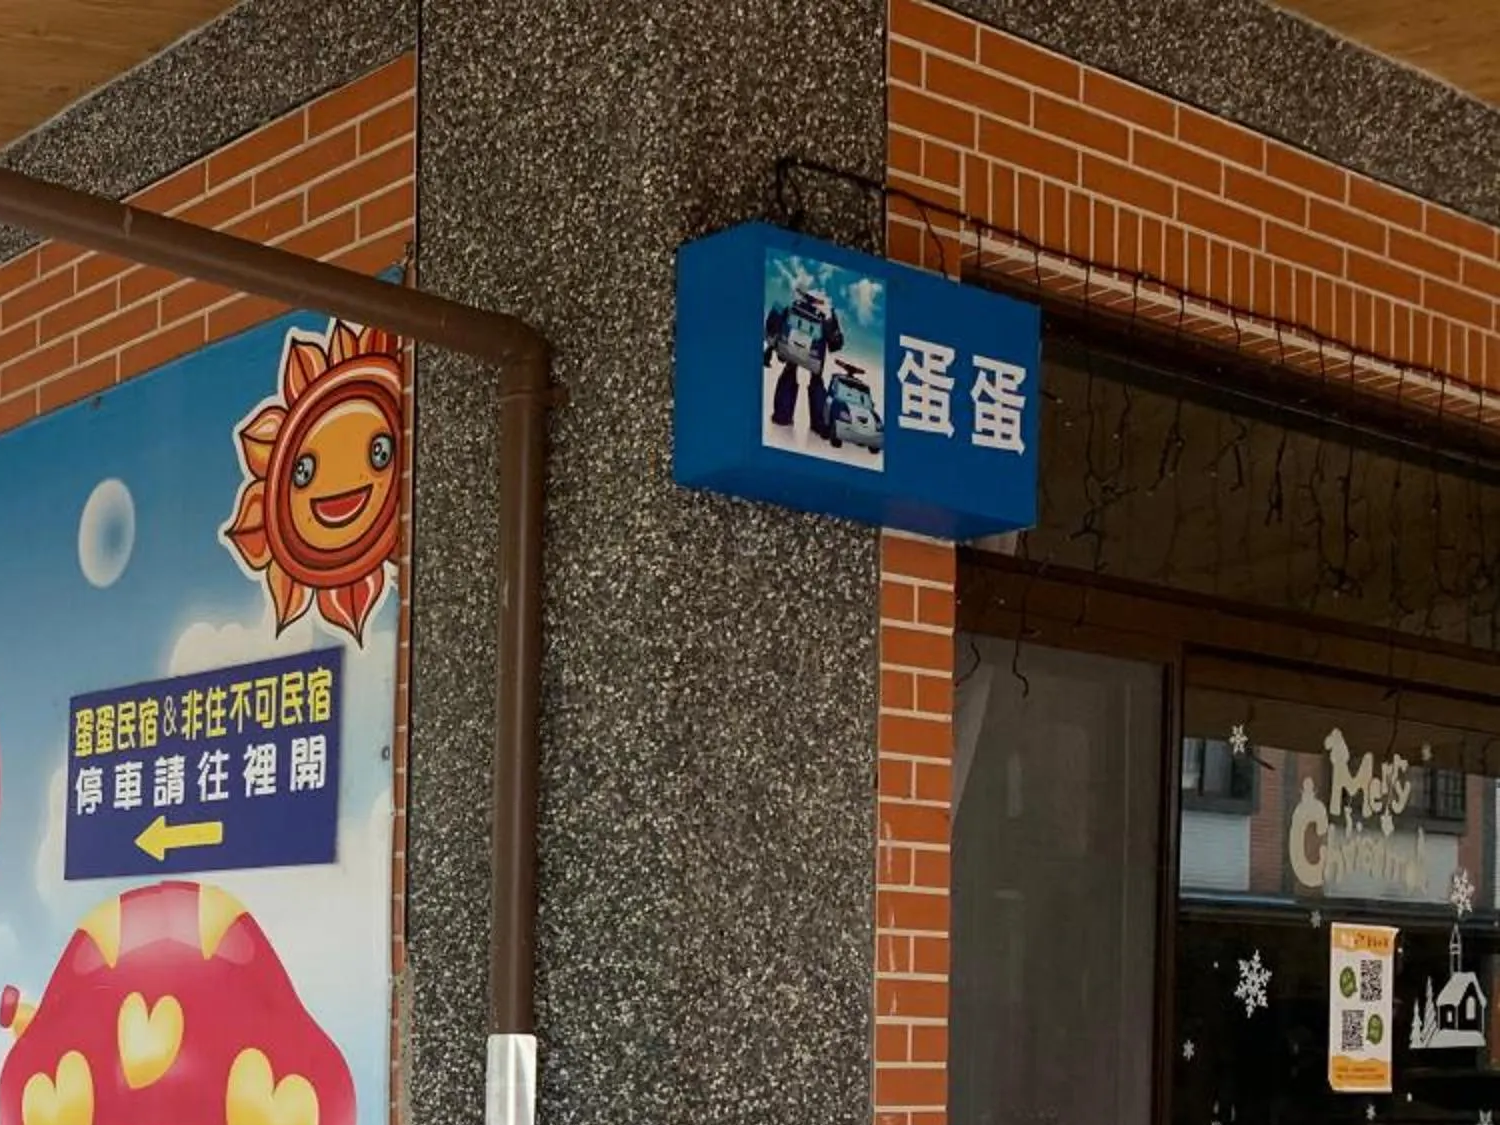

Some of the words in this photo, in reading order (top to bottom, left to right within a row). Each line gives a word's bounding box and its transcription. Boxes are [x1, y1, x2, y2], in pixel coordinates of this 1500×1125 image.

[897, 334, 1027, 456] 蛋蛋
[75, 734, 328, 816] 停車請往裡開
